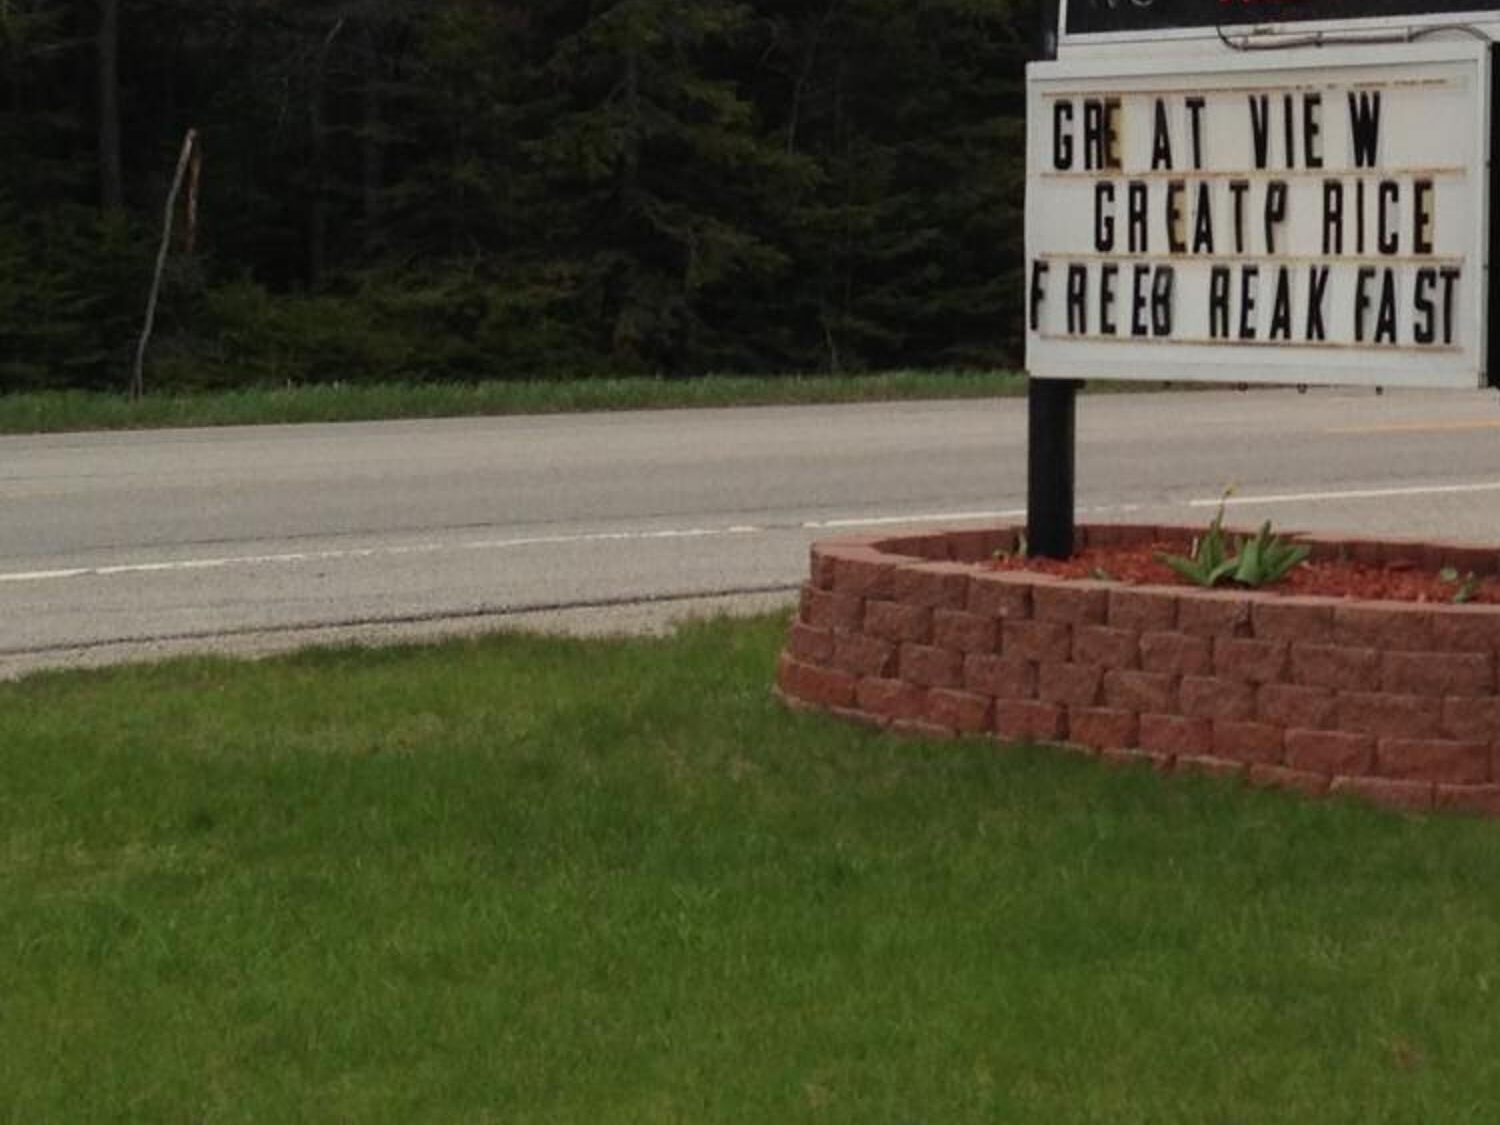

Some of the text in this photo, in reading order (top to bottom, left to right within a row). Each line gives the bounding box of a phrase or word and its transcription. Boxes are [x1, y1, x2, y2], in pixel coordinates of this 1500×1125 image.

[1052, 91, 1382, 171] GREAT VIEW
[1094, 180, 1435, 256] GREAT PRICE
[1030, 260, 1149, 337] FREE
